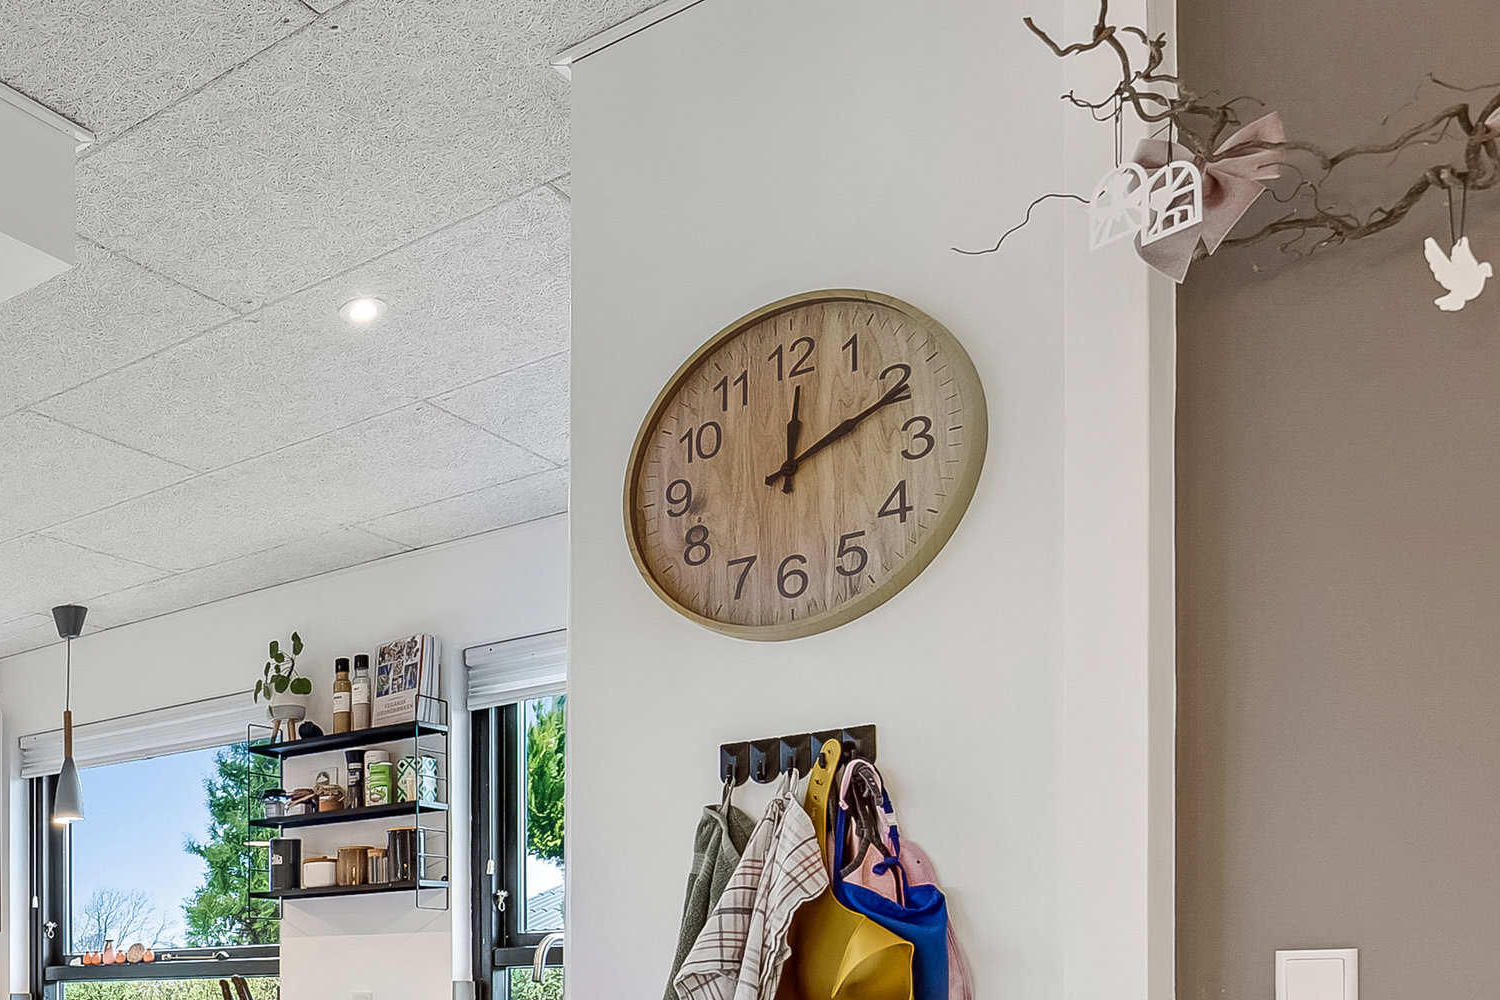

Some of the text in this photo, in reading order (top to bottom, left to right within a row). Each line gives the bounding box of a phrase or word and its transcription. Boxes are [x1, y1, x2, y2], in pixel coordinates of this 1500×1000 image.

[767, 335, 816, 383] 12
[841, 333, 858, 373] 1
[712, 369, 749, 412] 11
[878, 363, 912, 402] 2
[678, 421, 722, 464] 10
[900, 415, 935, 460] 3
[665, 478, 693, 518] 9
[877, 479, 914, 524] 4
[682, 524, 712, 567] 8
[834, 530, 870, 578] 5
[726, 554, 758, 601] 7
[776, 554, 809, 599] 6
